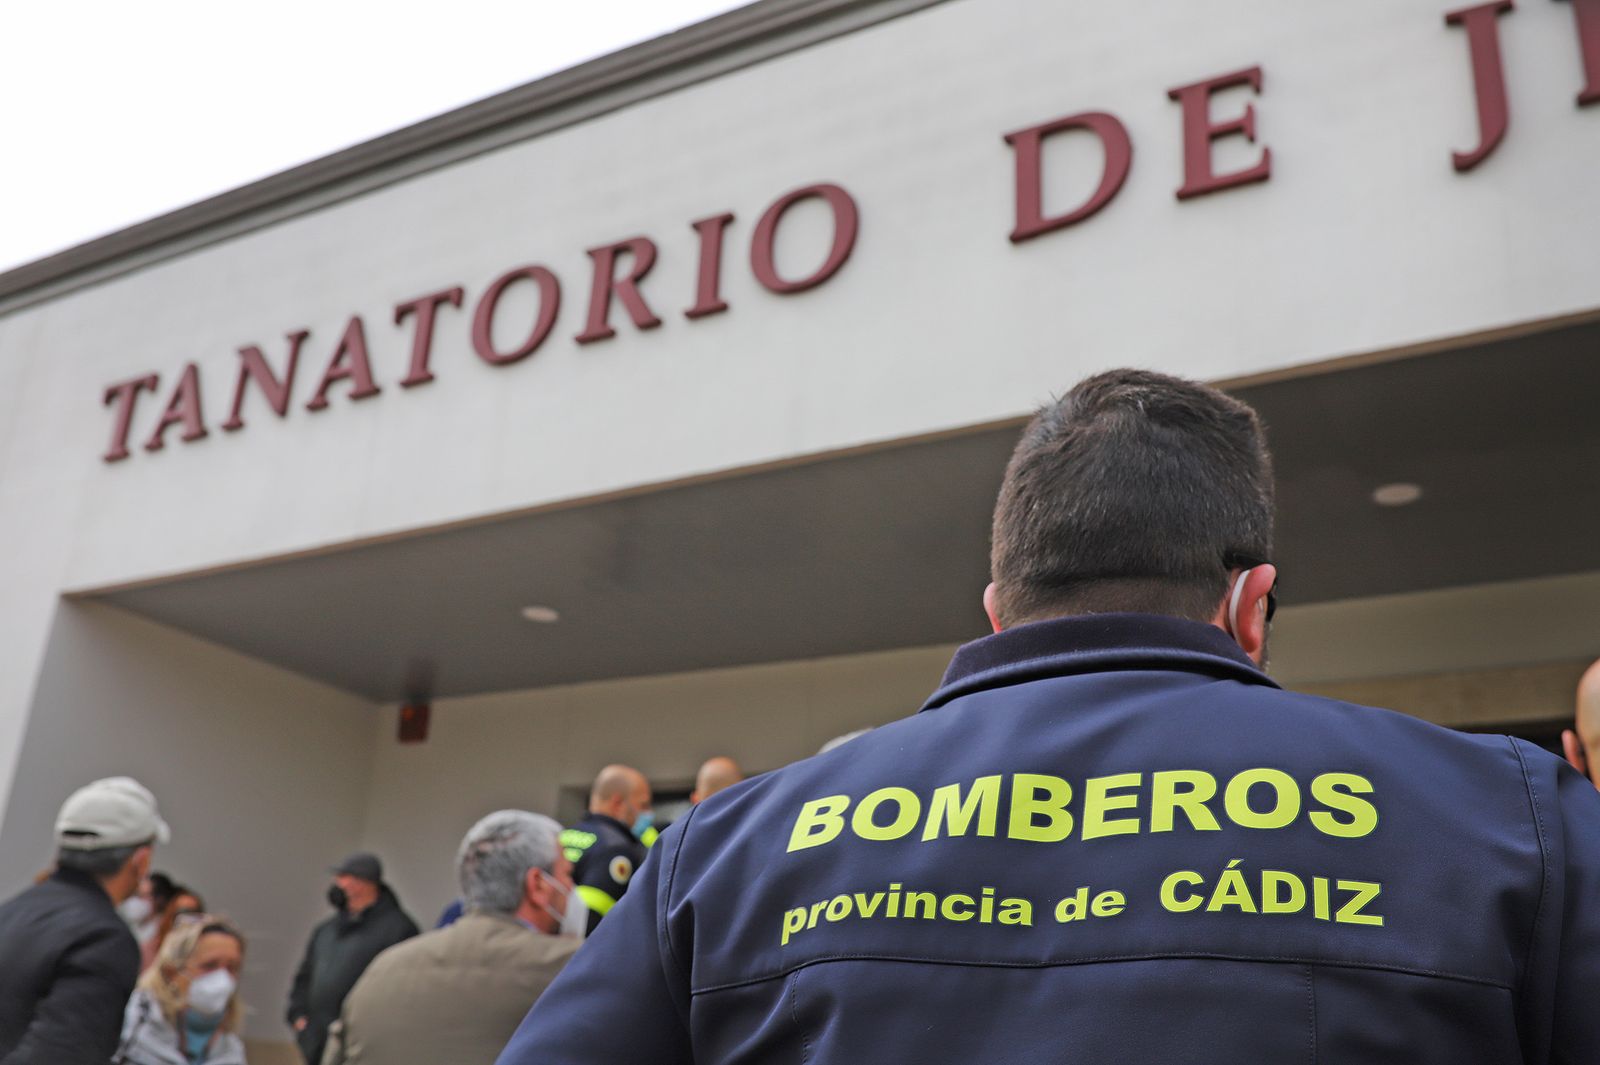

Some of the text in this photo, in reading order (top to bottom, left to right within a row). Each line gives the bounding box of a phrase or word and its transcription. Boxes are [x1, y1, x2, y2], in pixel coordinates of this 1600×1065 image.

[103, 0, 1600, 463] TANATORIO DE J
[787, 767, 1379, 852] BOMBEROS
[781, 859, 1384, 946] provincia de CÁDIZ
